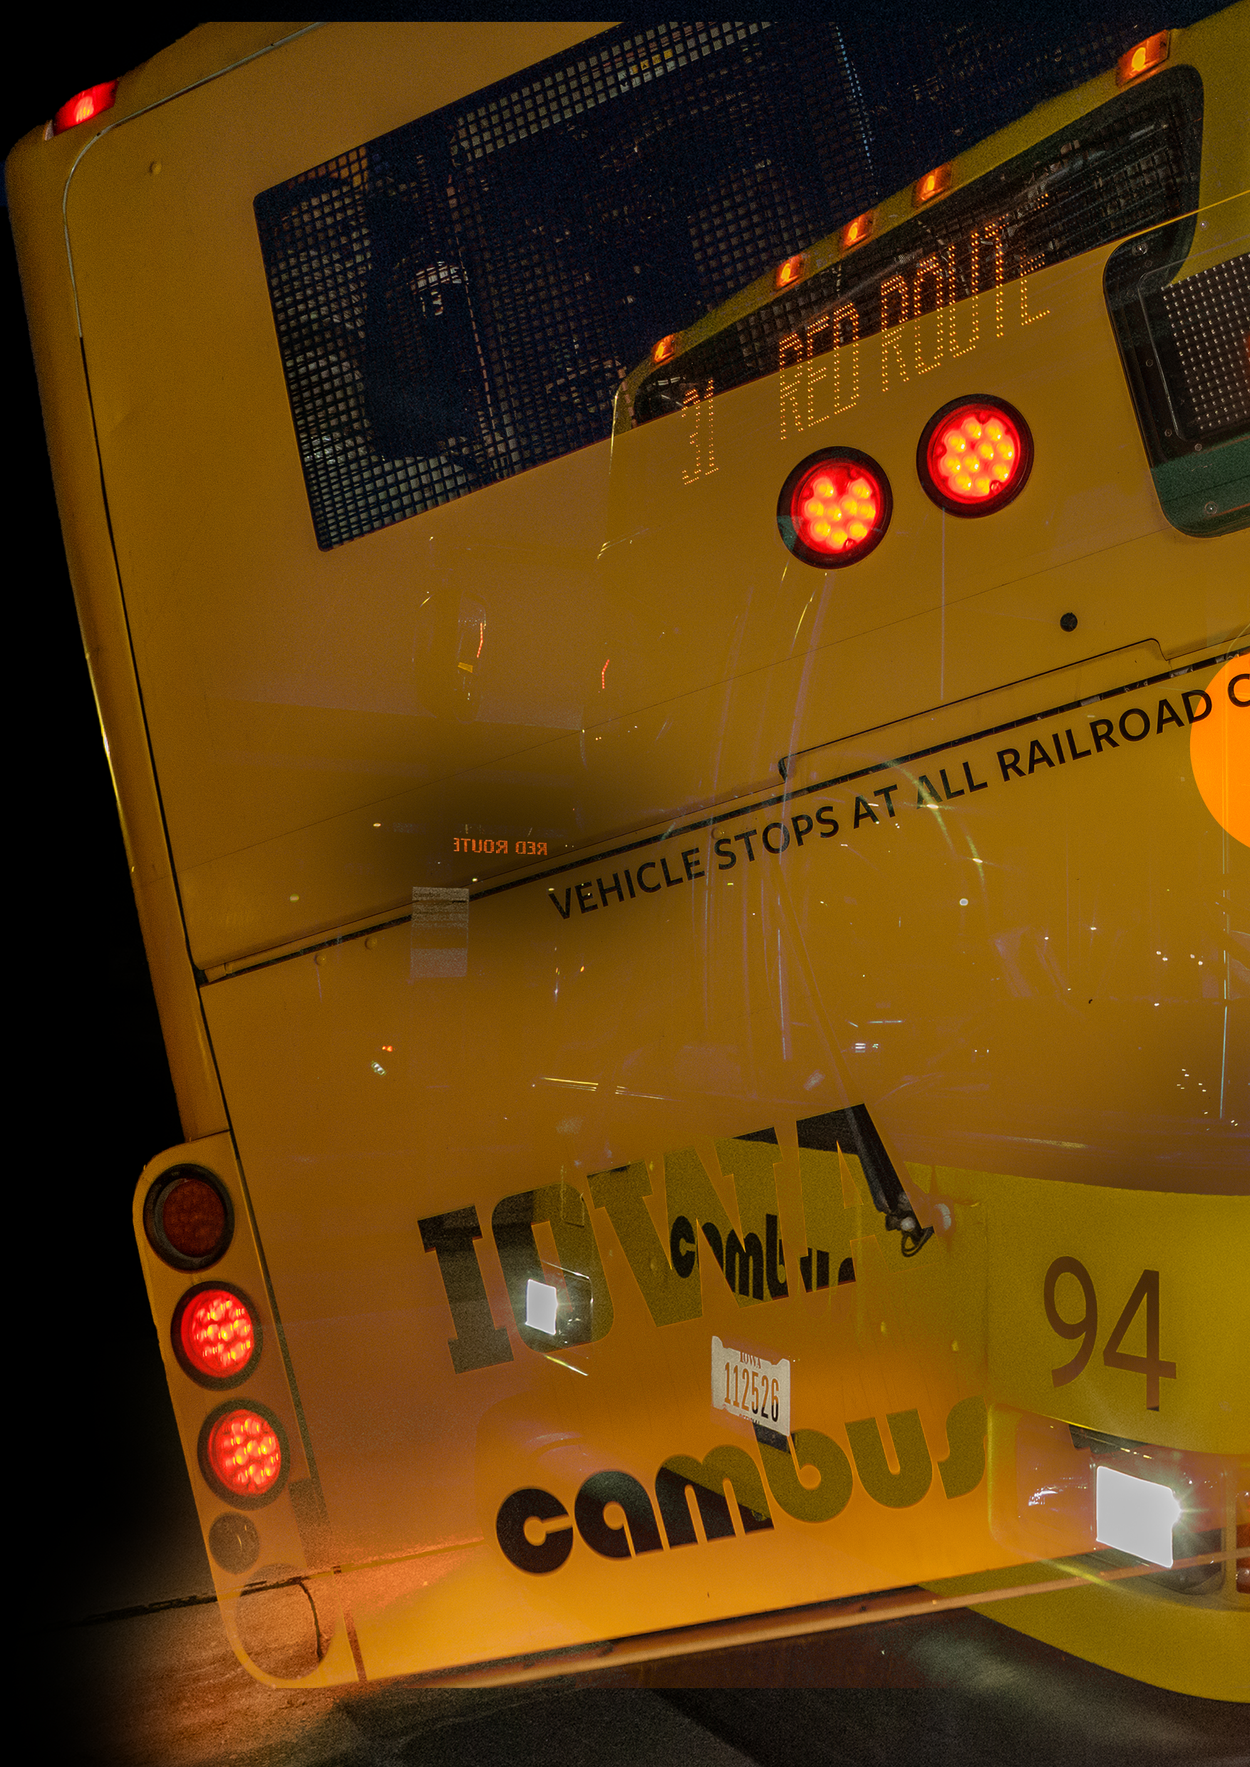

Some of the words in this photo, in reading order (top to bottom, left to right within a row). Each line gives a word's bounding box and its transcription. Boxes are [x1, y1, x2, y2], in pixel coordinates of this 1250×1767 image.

[778, 301, 862, 441] RED
[879, 195, 1052, 393] ROUTE
[548, 847, 706, 920] VEHICLE
[713, 805, 840, 870] STOPS
[852, 784, 900, 830] AT
[915, 760, 990, 811] ALL
[997, 688, 1214, 784] RAILROAD
[417, 1103, 938, 1375] IOWA
[1043, 1255, 1177, 1413] 94
[496, 1397, 986, 1577] cambus
[724, 1361, 780, 1423] 112526
